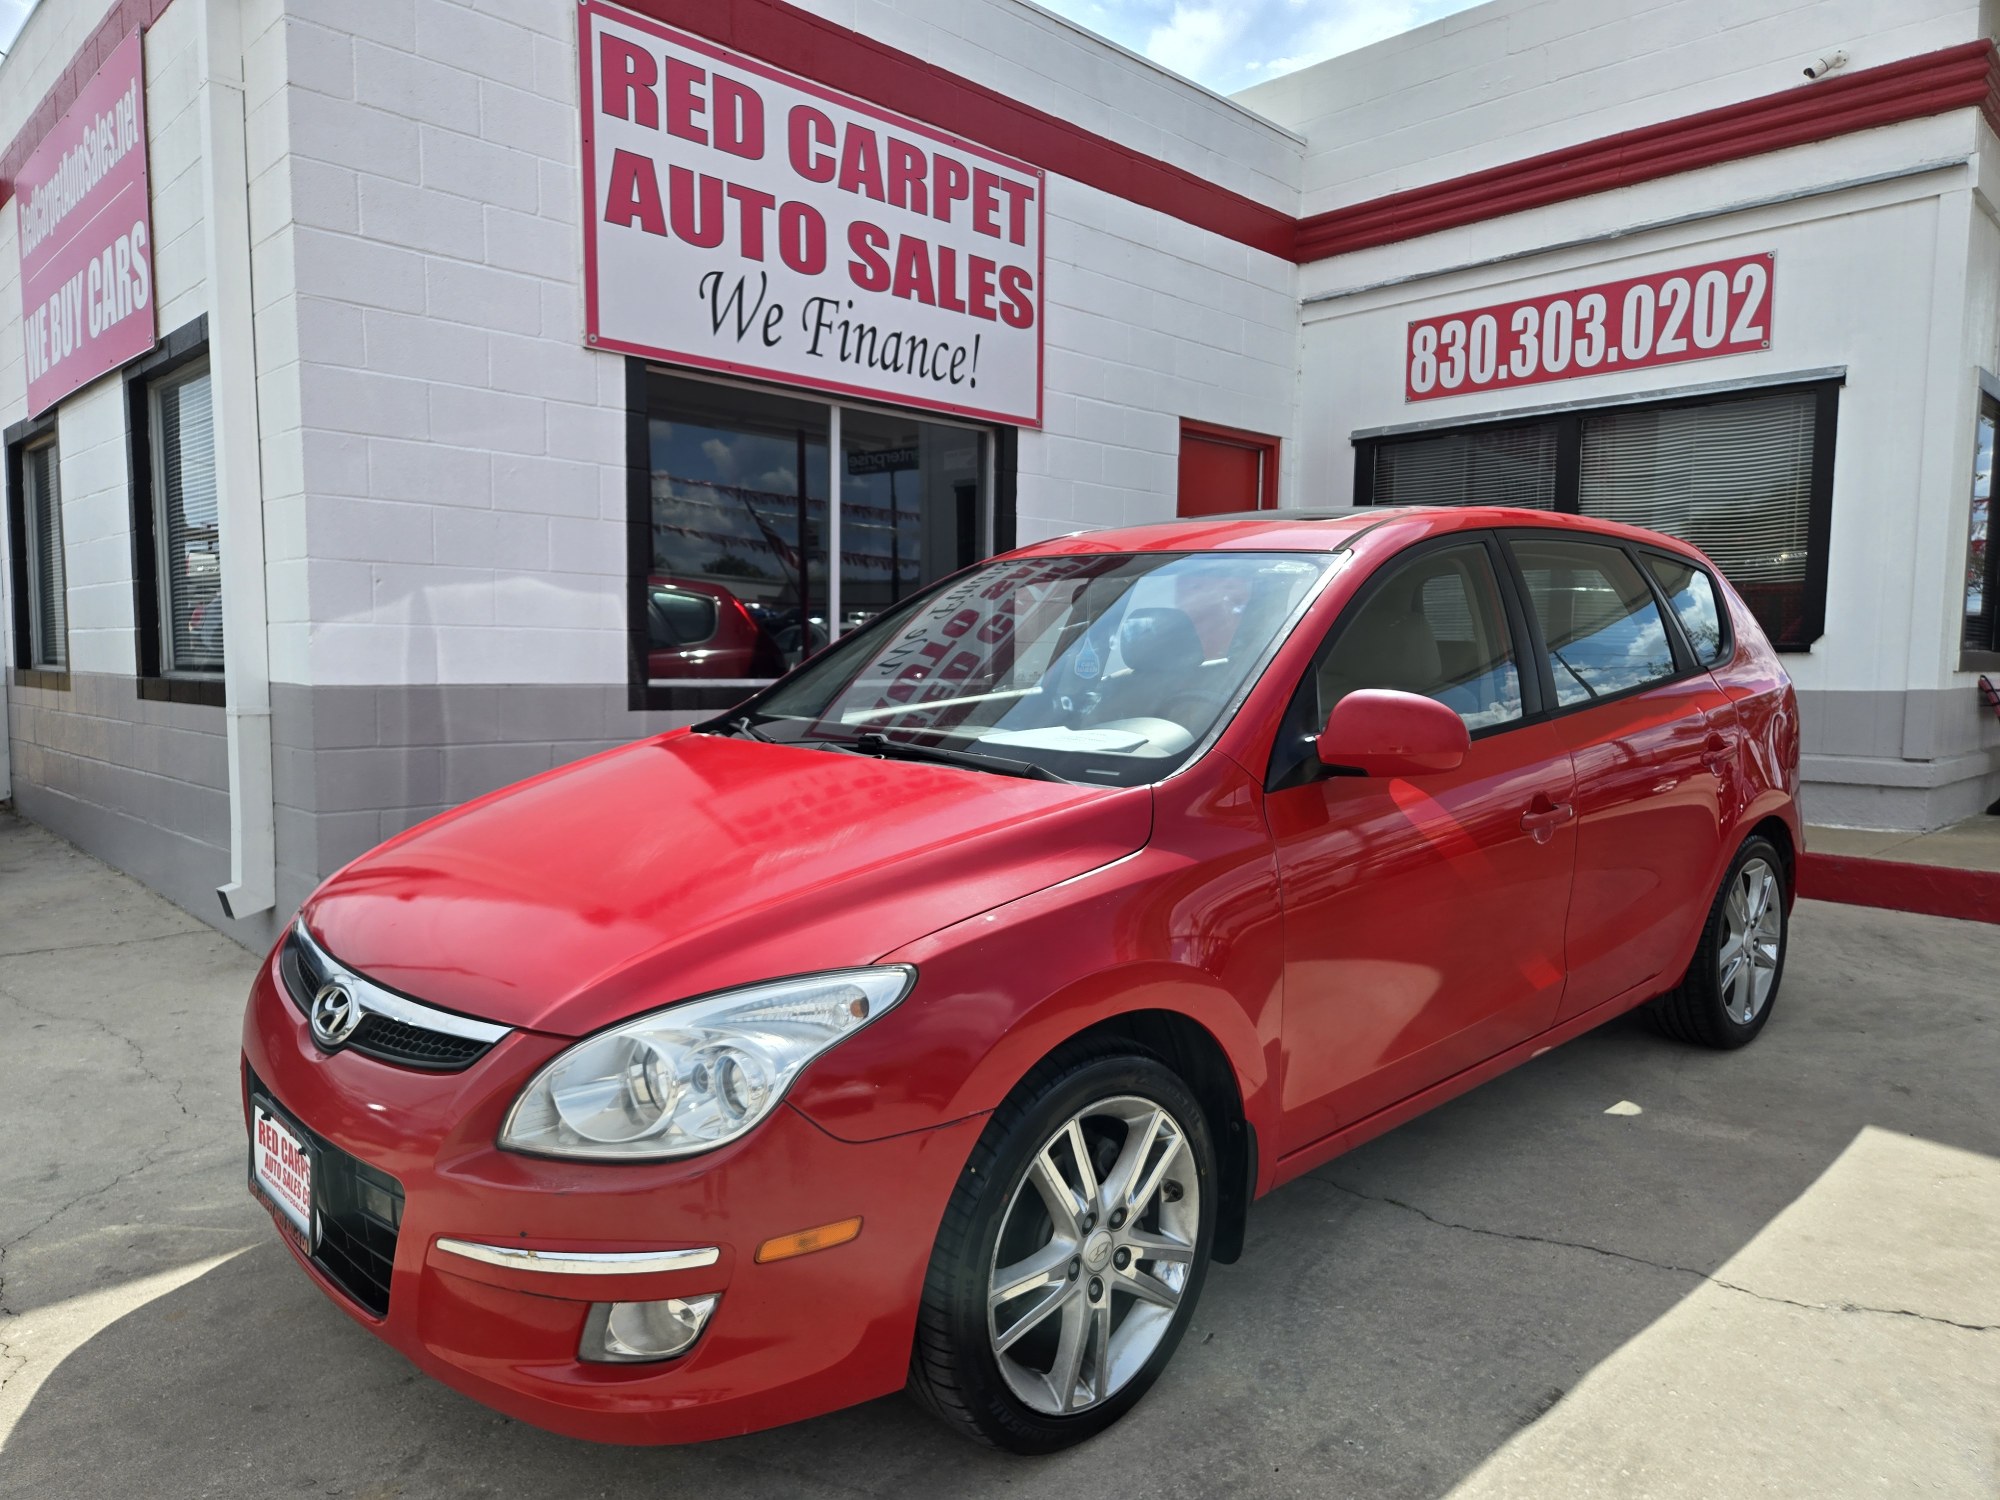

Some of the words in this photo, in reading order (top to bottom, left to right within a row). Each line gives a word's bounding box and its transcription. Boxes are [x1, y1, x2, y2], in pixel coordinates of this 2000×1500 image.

[20, 78, 139, 260] RedCarpetAutoSales.net
[600, 31, 765, 160] RED
[788, 105, 1035, 247] CARPET
[25, 310, 48, 385] WE
[50, 273, 84, 368] BUY
[88, 220, 149, 340] CARS
[604, 148, 827, 275] AUTO
[847, 220, 1034, 329] SALES
[699, 270, 783, 347] We
[802, 296, 980, 388] Finance!
[1411, 263, 1767, 394] 830.303.0202
[258, 1119, 278, 1156] RED
[265, 1152, 281, 1181] AUTO
[282, 1168, 302, 1198] SALES
